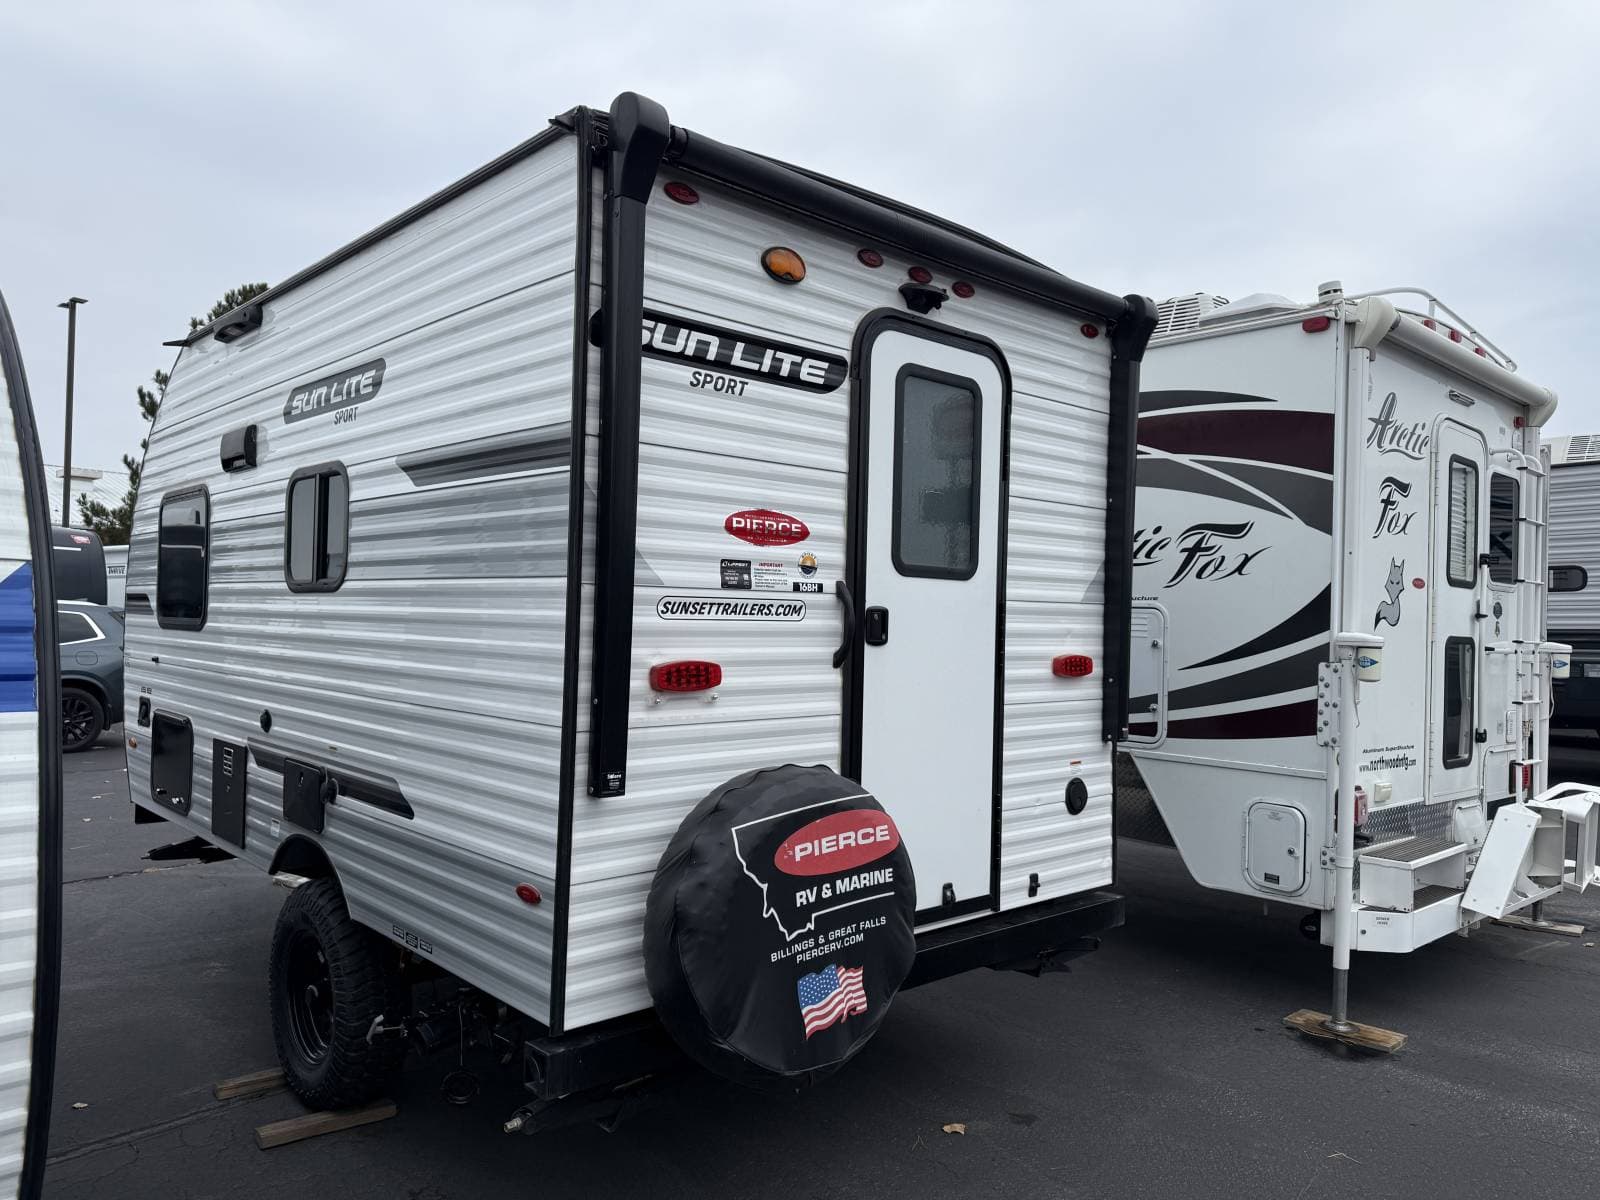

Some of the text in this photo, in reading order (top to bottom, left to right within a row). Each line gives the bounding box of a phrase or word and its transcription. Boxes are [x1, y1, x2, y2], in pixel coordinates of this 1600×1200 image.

[730, 341, 830, 384] LITE
[291, 369, 376, 416] SUN LITE
[689, 370, 749, 397] SPORT
[333, 406, 359, 425] SPORT
[1366, 391, 1430, 460] Arctic
[1372, 476, 1418, 539] Fox
[732, 517, 802, 537] PIERCE
[1162, 520, 1273, 589] Fox
[800, 582, 818, 592] 16BH
[660, 600, 805, 617] SUNSETTRAILERS.COM
[794, 825, 890, 862] PIERCE
[795, 868, 894, 908] RV & MARINE
[770, 916, 887, 963] BILLINGS & GREAT FALLS
[796, 933, 864, 964] PIERCERV.COM
